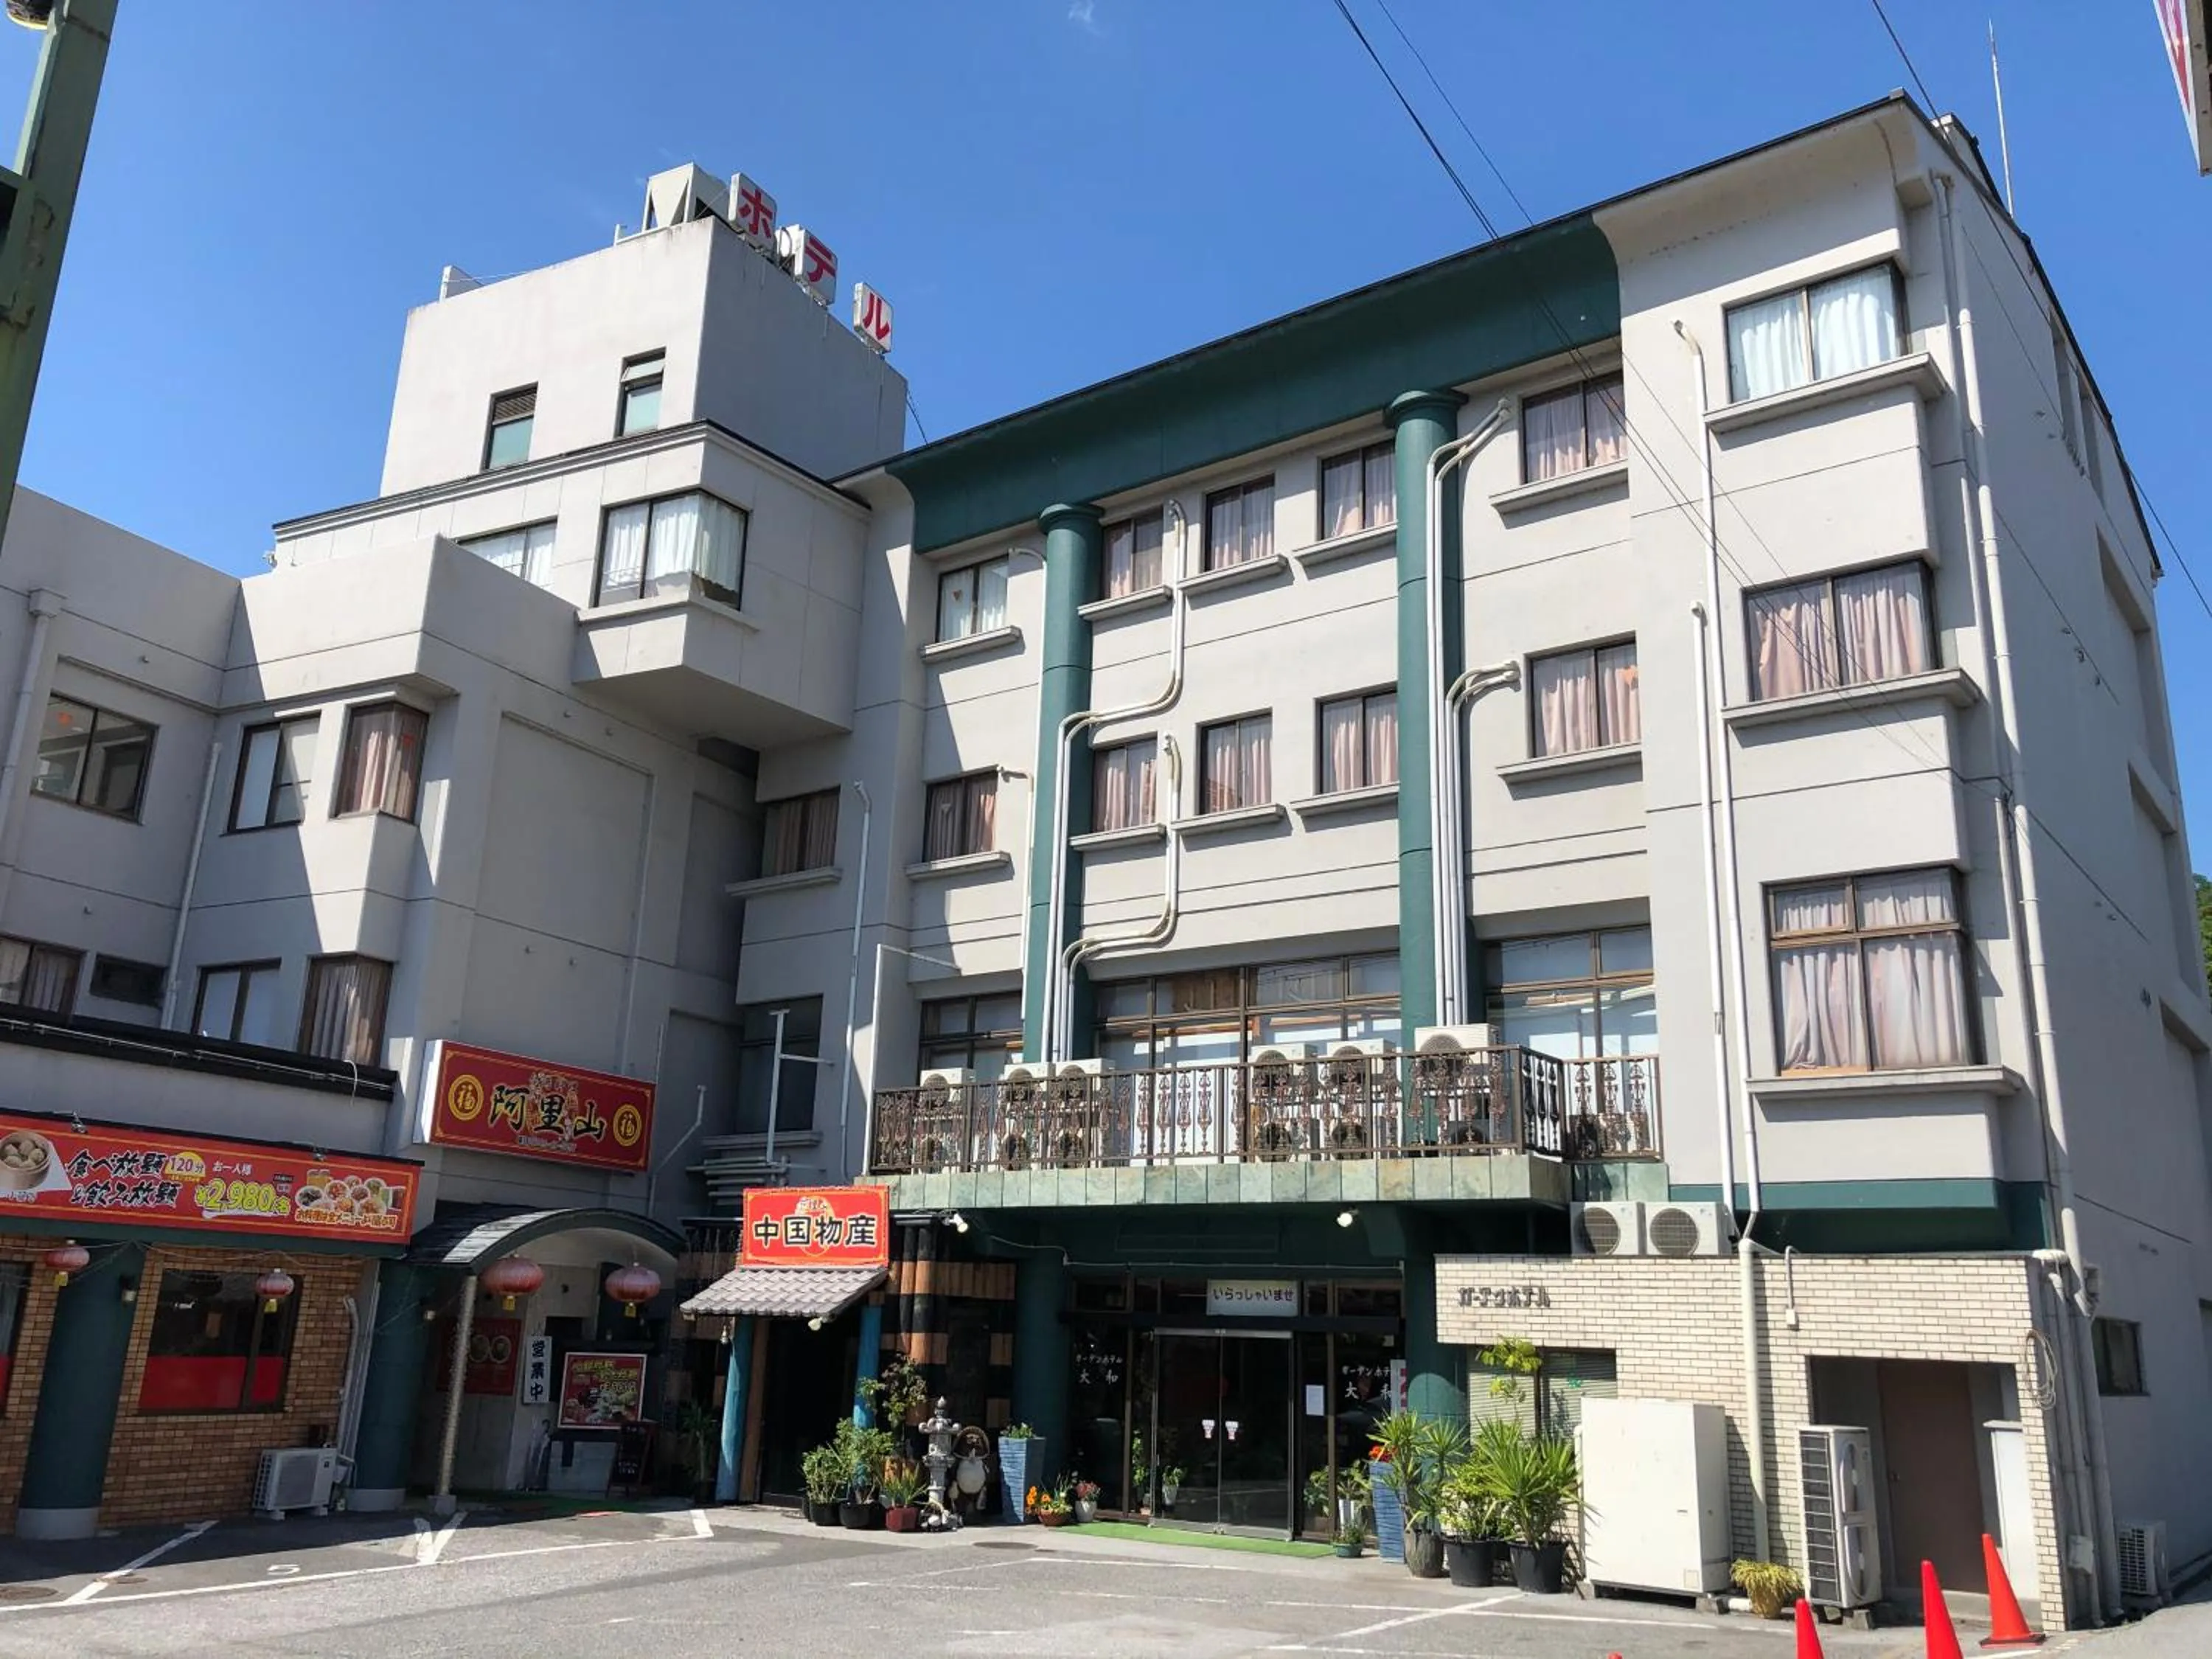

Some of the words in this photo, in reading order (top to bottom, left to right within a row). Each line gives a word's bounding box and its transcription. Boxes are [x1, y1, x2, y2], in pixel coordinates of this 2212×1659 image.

[739, 188, 890, 341] ホテル
[489, 1084, 607, 1141] 阿里山
[67, 1150, 167, 1178] 食べ放題
[170, 1157, 204, 1173] 120分
[754, 1214, 876, 1247] 中国物産
[1213, 1287, 1294, 1301] いらっしゃいませ
[530, 1340, 545, 1400] 営業中
